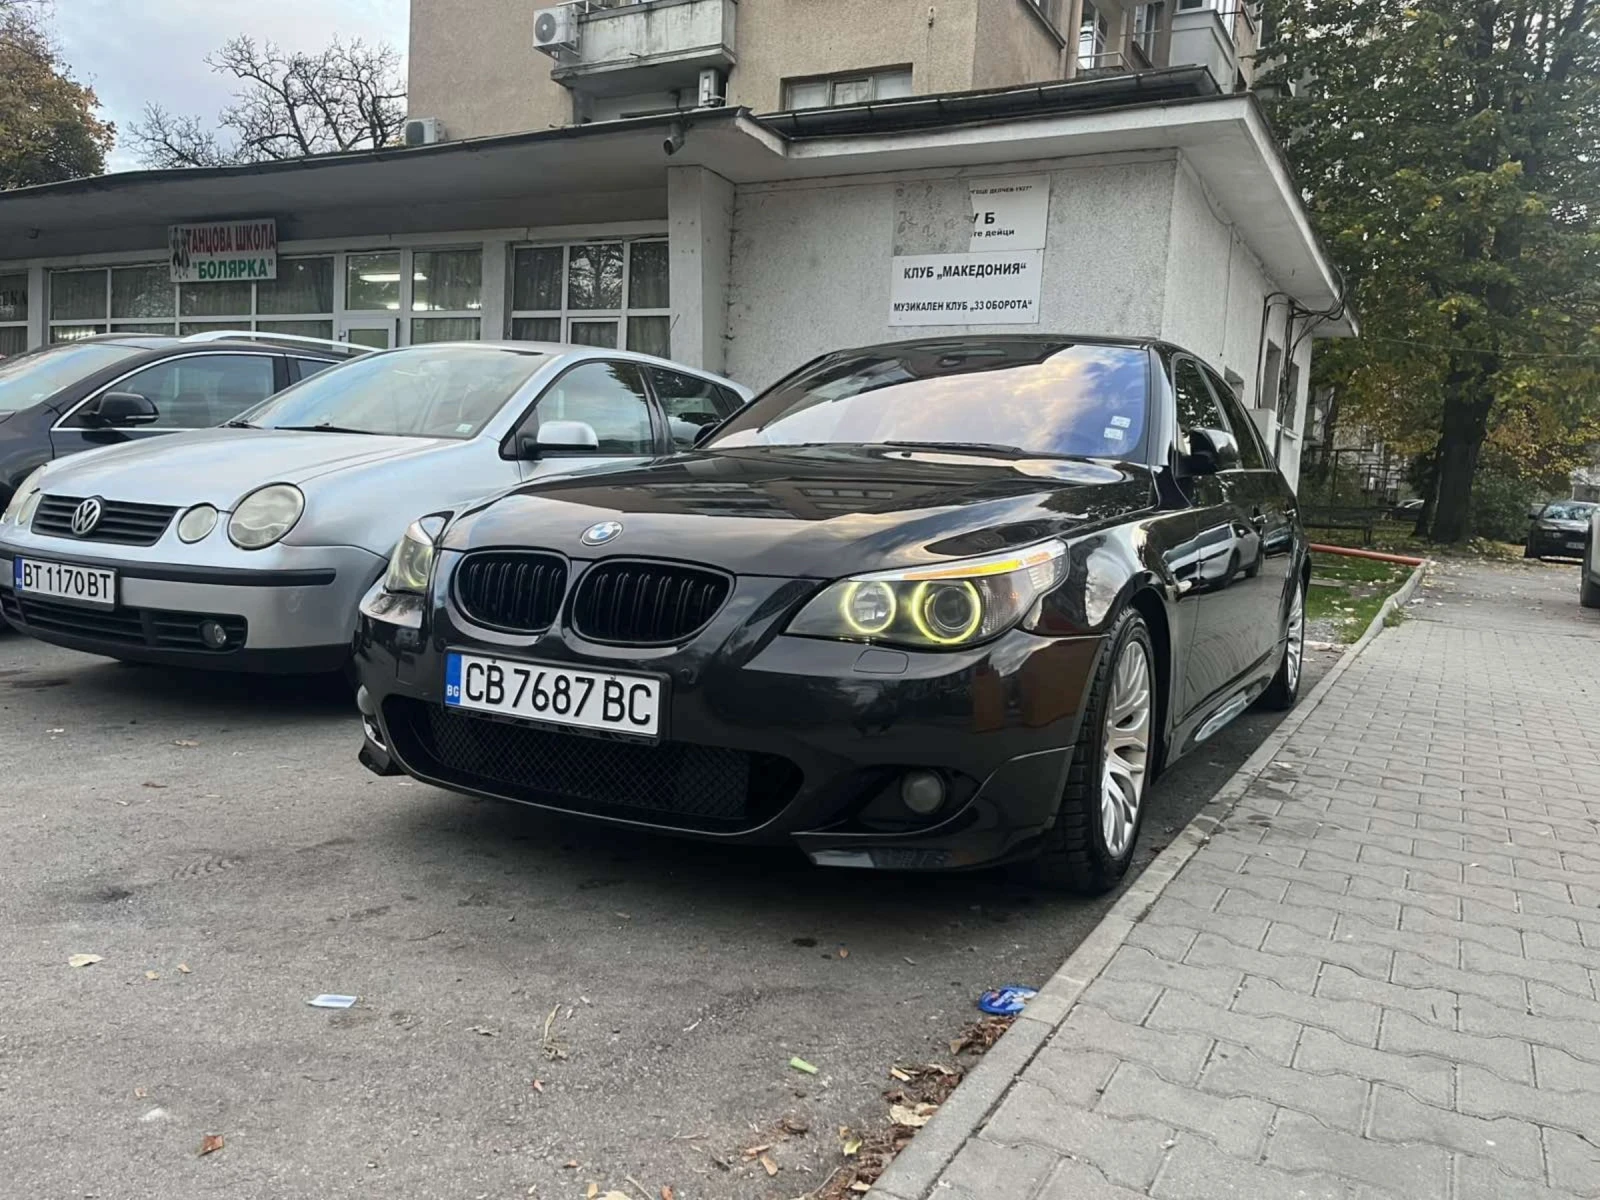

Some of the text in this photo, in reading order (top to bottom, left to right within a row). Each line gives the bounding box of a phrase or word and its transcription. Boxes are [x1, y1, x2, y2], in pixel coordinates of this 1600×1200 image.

[235, 223, 275, 251] ШКОЛА
[985, 229, 1015, 237] дейци
[904, 266, 934, 279] КЛУБ
[893, 301, 944, 312] МУЗИКАЛЕН
[945, 301, 968, 311] КЛУБ
[446, 685, 460, 697] BG
[512, 668, 596, 717] 7687
